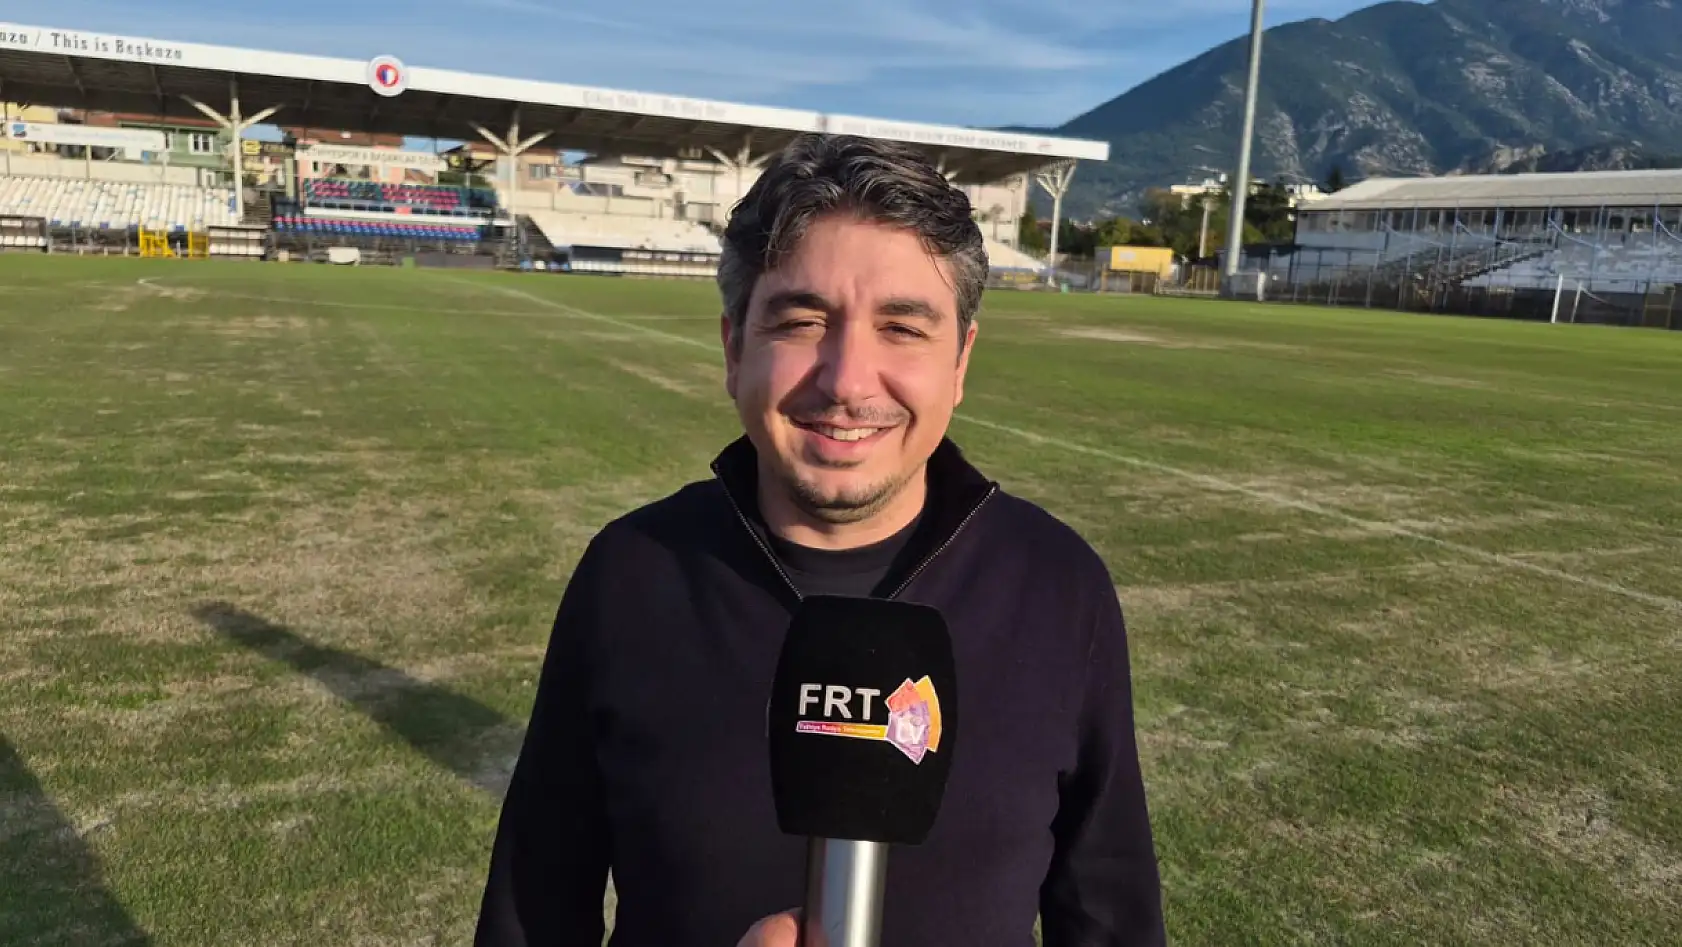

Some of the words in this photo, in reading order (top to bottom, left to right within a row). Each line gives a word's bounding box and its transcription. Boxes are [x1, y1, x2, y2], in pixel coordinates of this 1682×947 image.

[51, 32, 87, 50] This
[95, 37, 108, 52] is
[115, 39, 182, 60] Beşkaza
[799, 684, 880, 719] FRT
